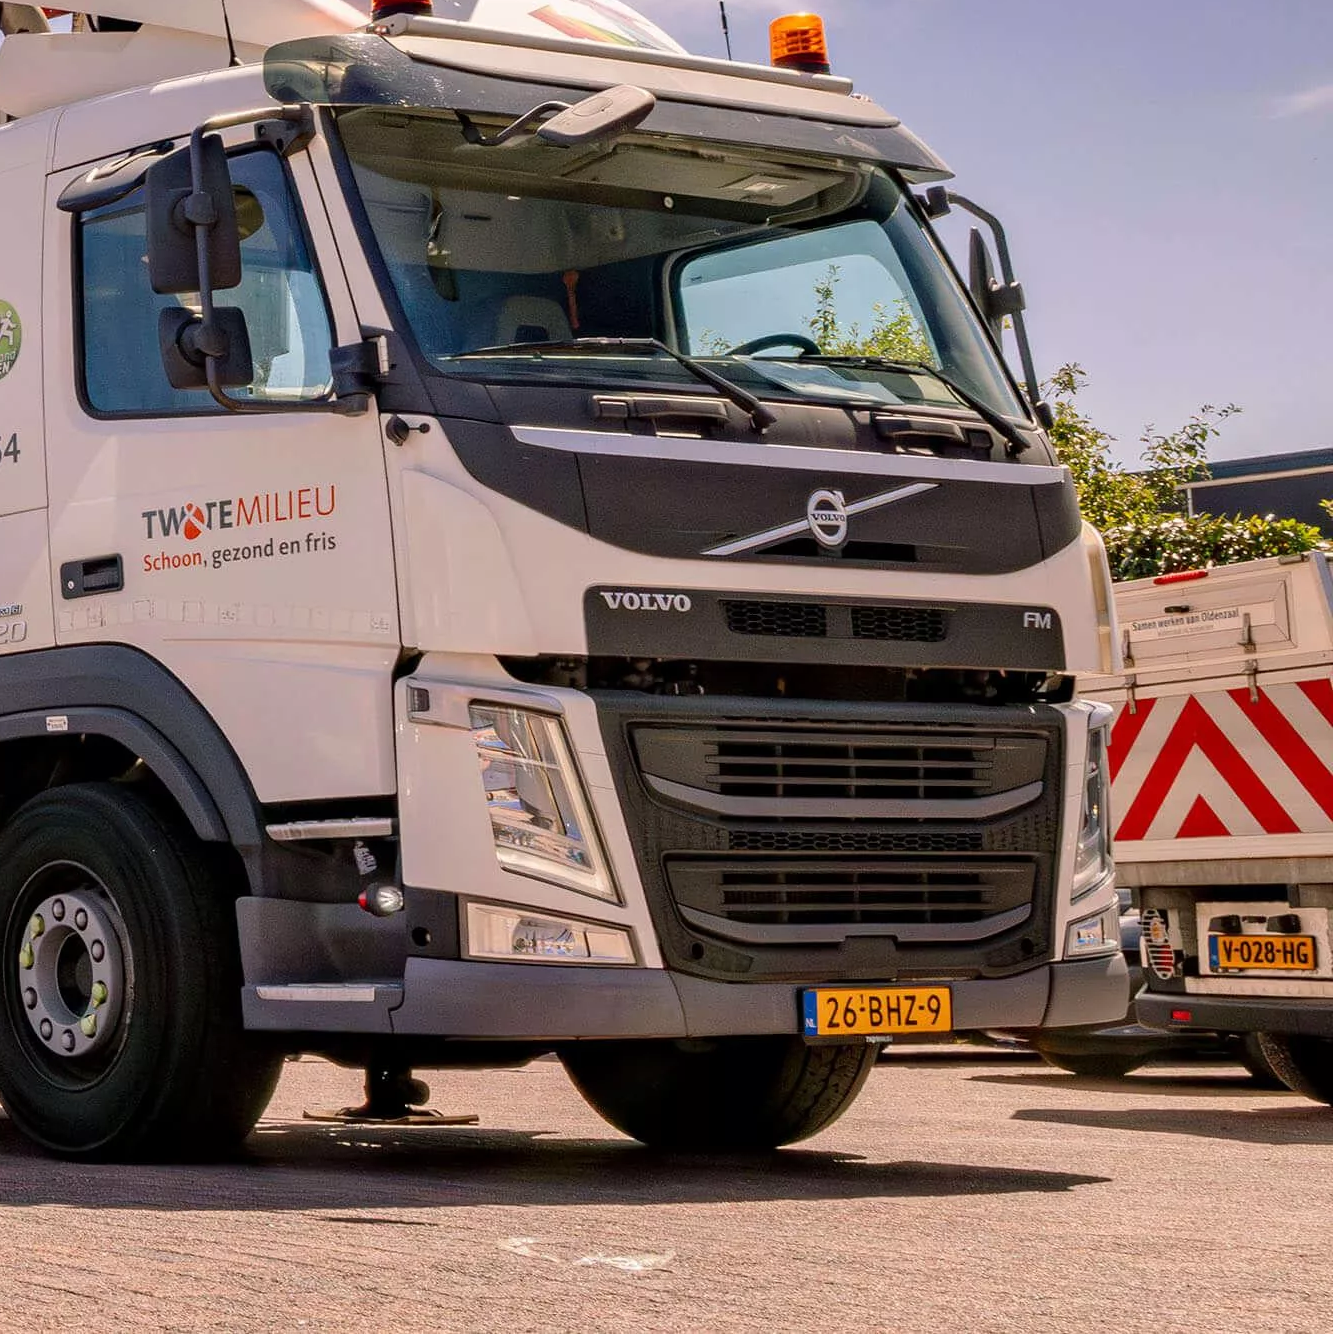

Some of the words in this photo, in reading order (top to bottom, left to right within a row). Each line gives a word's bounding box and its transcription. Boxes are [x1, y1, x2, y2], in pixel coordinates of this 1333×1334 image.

[810, 512, 845, 523] VOLVO
[143, 551, 208, 572] Schoon,
[212, 538, 274, 569] gezond
[279, 539, 301, 556] en
[305, 532, 337, 553] fris
[600, 591, 692, 612] VOLVO
[1023, 612, 1052, 629] FM
[1132, 620, 1157, 632] Samen
[1222, 940, 1309, 964] V-028-HG
[805, 1018, 817, 1029] NL
[827, 994, 942, 1029] 26-BHZ-9
